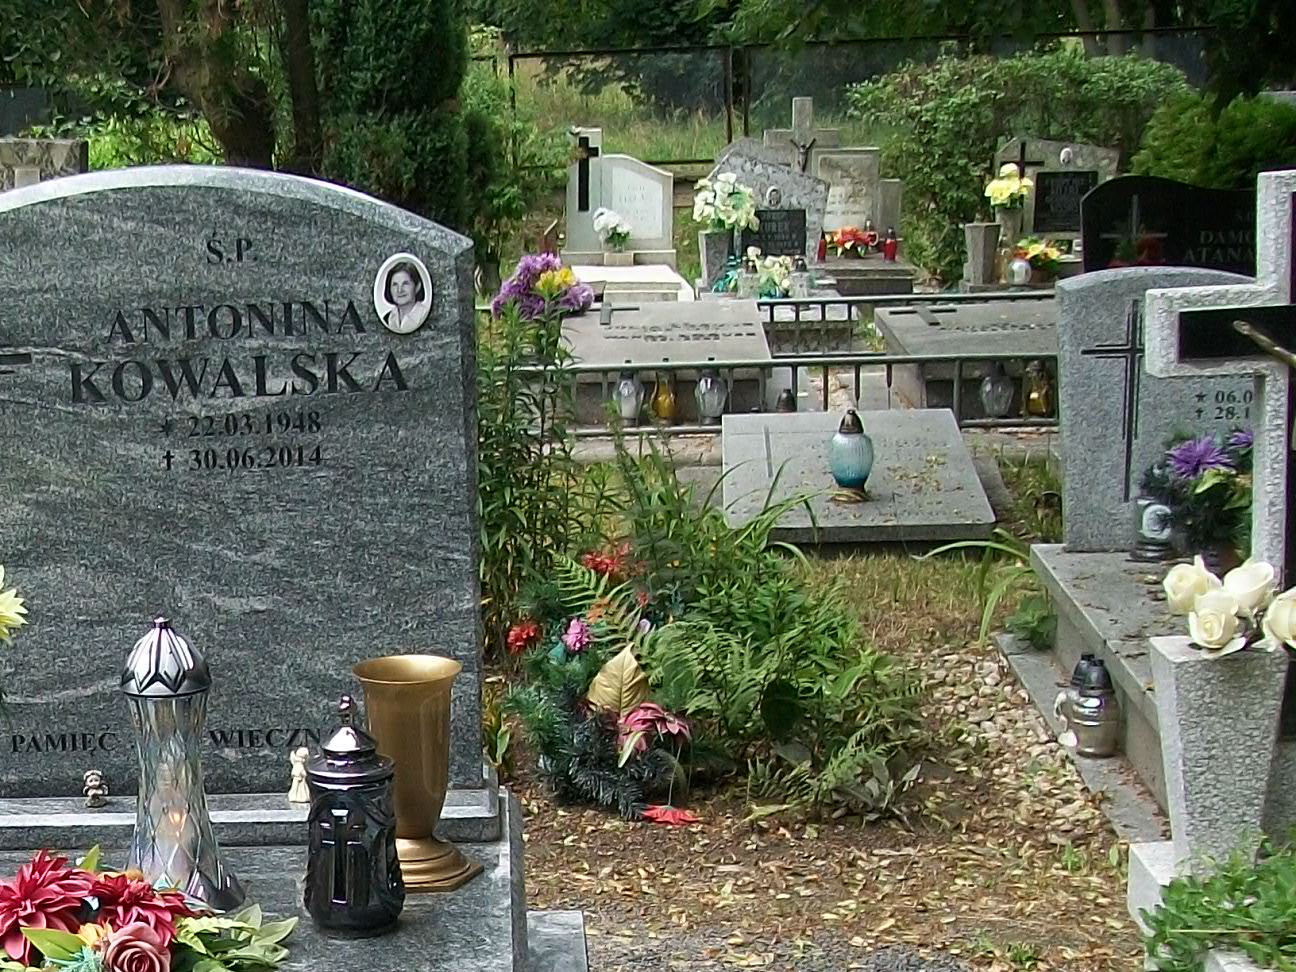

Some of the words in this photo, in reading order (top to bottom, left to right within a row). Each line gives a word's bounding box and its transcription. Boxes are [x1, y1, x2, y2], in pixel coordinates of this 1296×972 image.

[108, 299, 366, 344] ANTONINA
[70, 350, 409, 404] KOWALSKA
[188, 411, 321, 438] 22.03.1948
[188, 446, 326, 472] 30.06.2014
[12, 727, 116, 758] PAMIĘĆ
